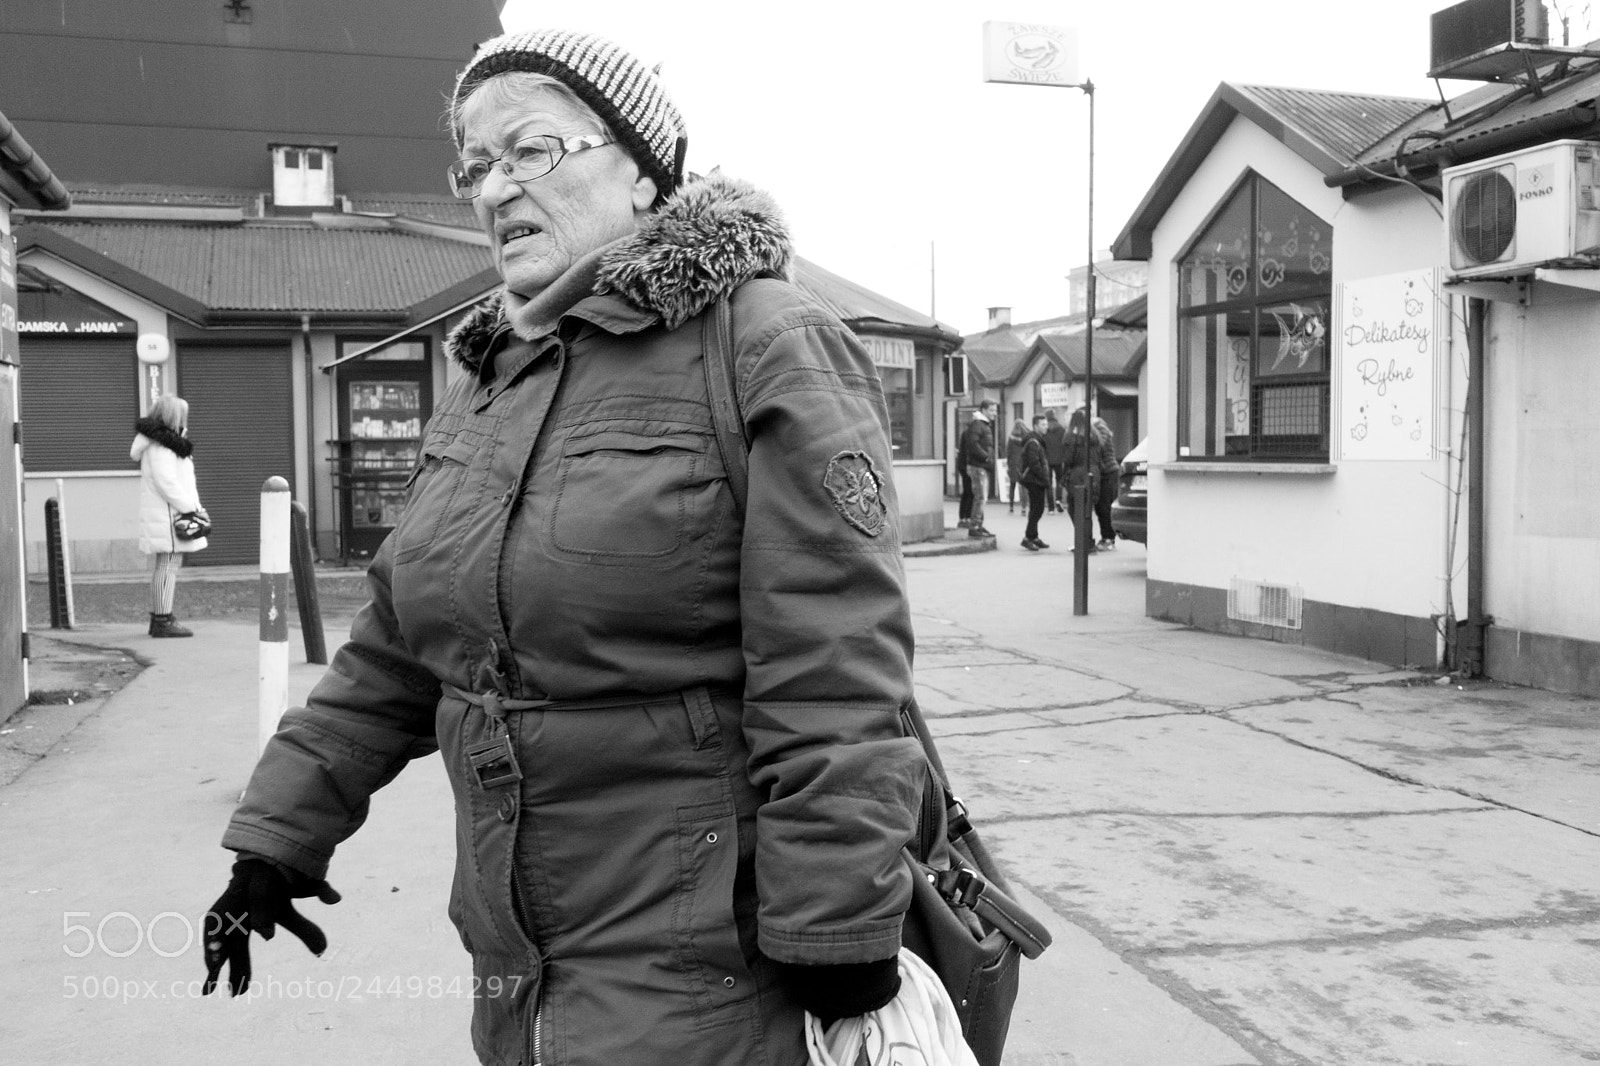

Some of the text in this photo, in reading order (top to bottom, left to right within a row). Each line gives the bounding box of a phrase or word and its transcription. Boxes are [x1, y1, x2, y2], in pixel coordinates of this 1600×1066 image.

[16, 321, 68, 332] DAMSKA
[1344, 320, 1430, 354] Delikatesy
[1356, 358, 1414, 397] Rybne
